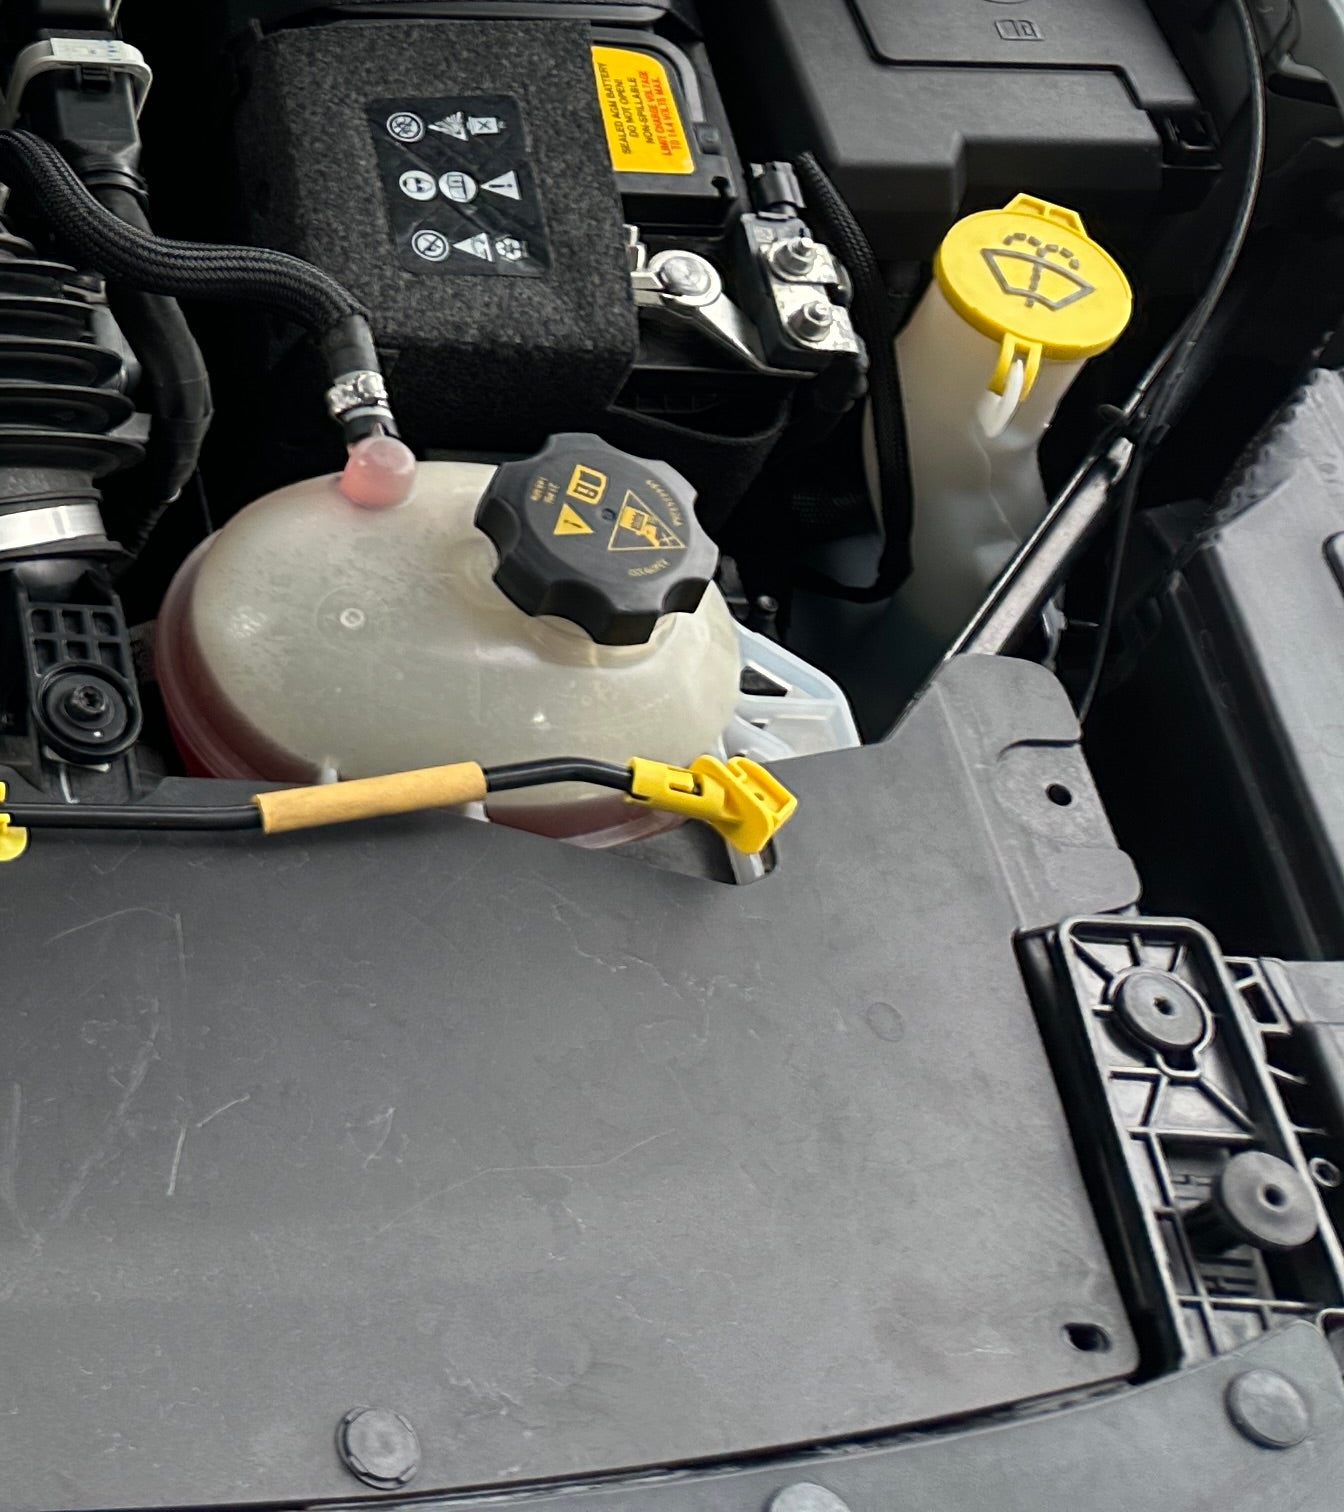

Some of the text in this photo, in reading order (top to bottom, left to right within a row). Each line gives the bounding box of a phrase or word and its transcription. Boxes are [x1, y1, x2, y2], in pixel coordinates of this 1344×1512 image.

[598, 62, 631, 154] SEALED AGM BATTERY
[622, 107, 633, 123] NOT
[627, 77, 655, 144] NON-SPILLABLE
[627, 125, 639, 138] DO
